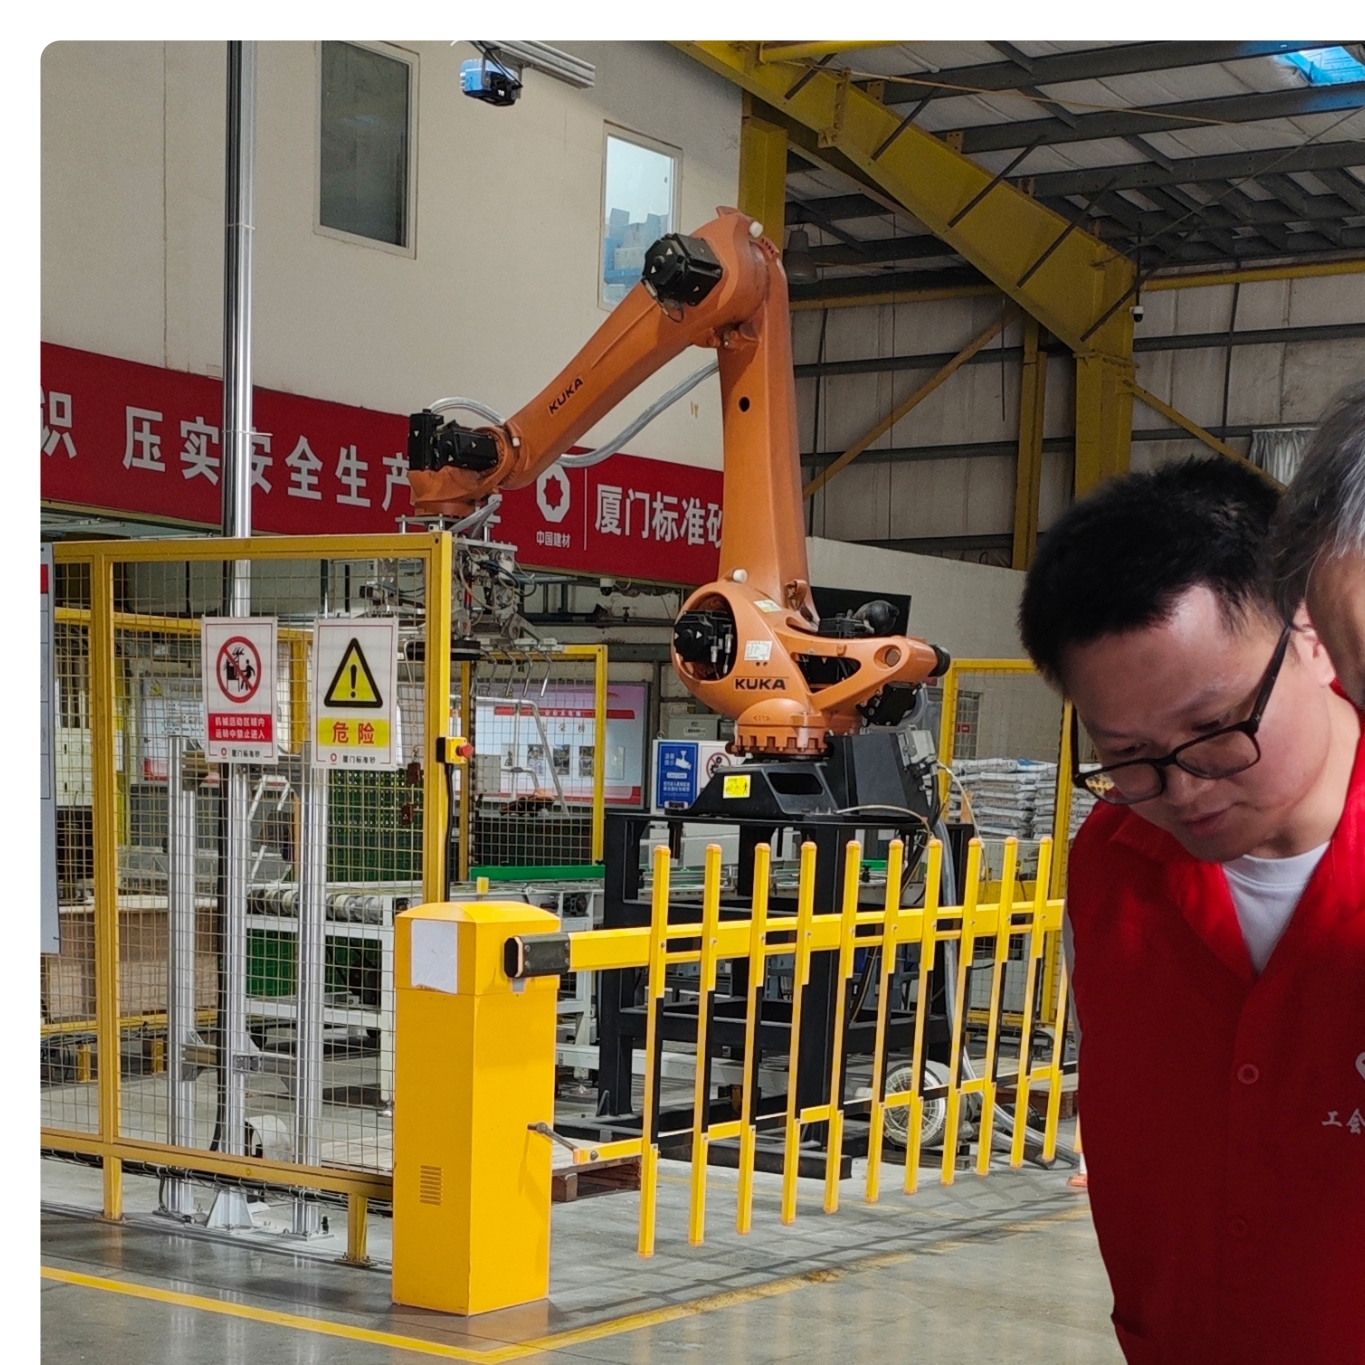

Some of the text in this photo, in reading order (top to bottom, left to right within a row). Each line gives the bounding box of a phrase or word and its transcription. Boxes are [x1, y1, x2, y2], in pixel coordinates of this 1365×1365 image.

[549, 376, 584, 415] KUKA
[537, 531, 571, 549] 中国建材
[735, 678, 787, 691] KUKA
[332, 721, 376, 745] 危险
[231, 749, 261, 759] 厦门标准砂
[342, 755, 377, 764] 厦门标准砂
